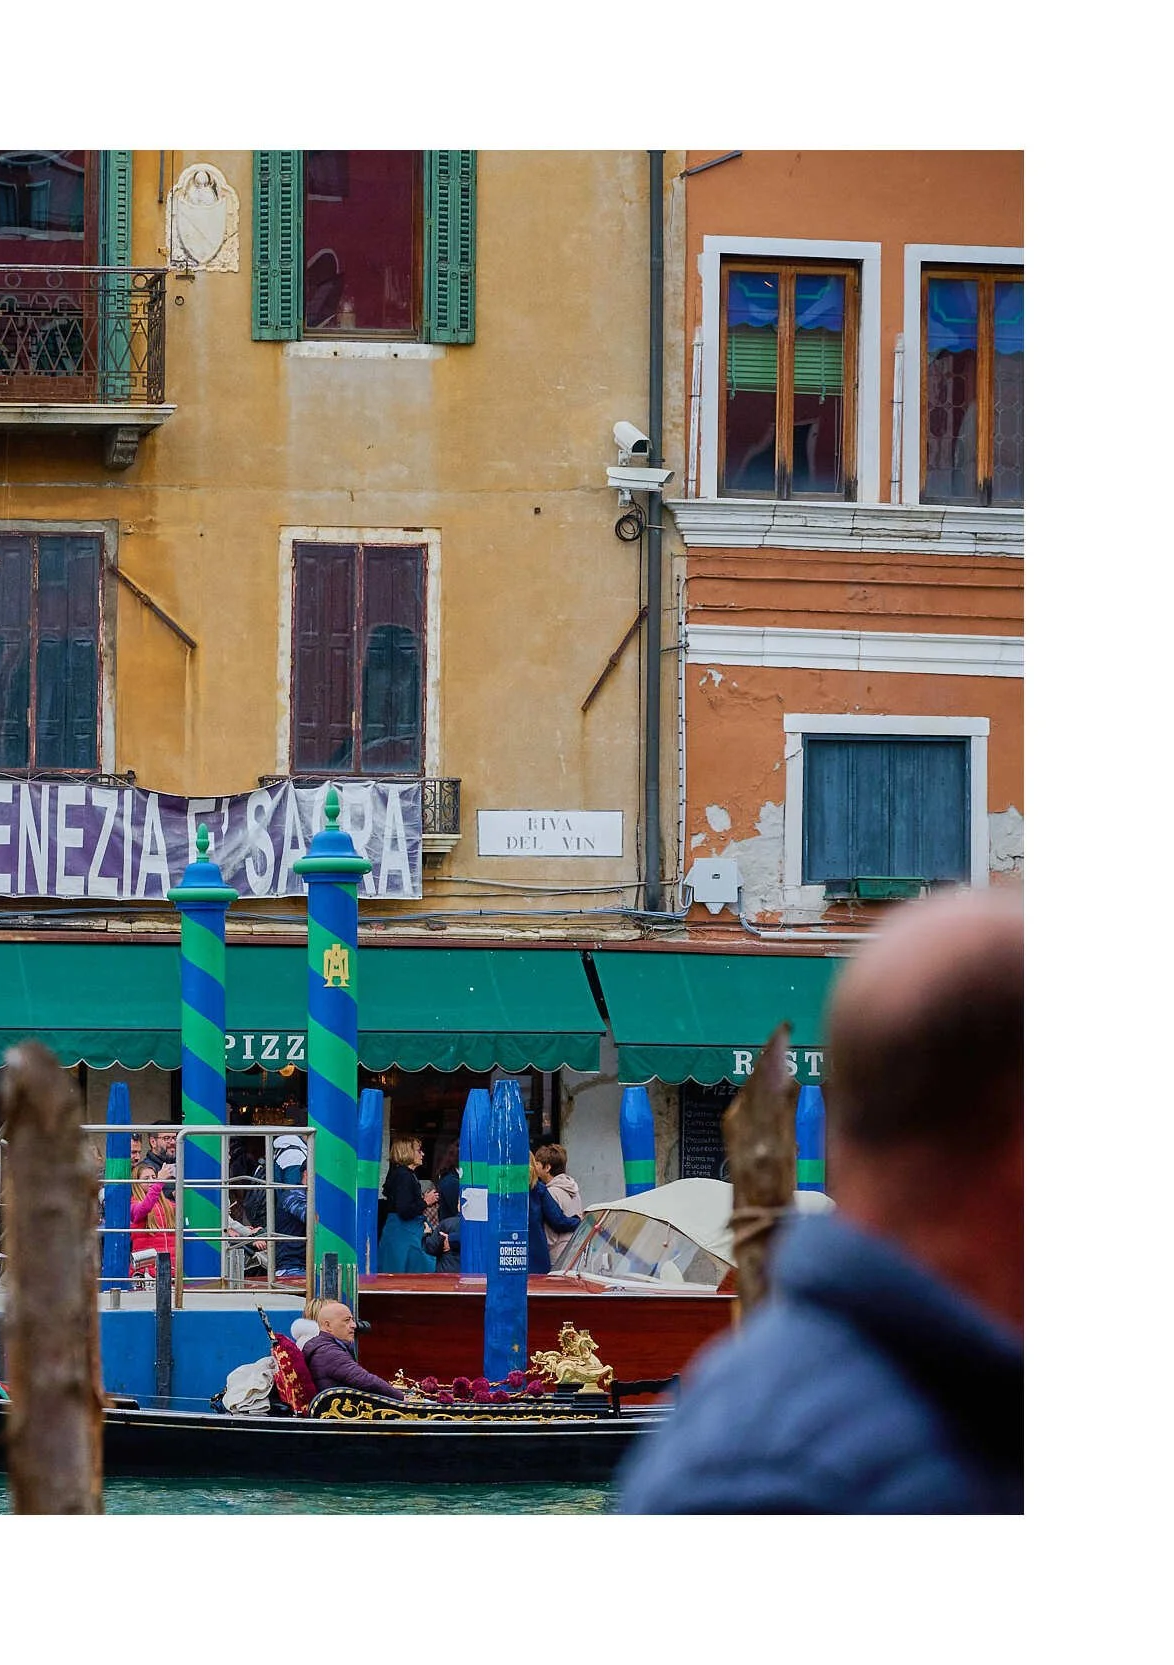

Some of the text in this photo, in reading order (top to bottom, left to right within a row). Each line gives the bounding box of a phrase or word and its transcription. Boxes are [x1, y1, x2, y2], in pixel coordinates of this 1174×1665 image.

[528, 817, 572, 831] RIVA
[506, 836, 595, 850] DEL VIN
[225, 1034, 305, 1060] PIZZ
